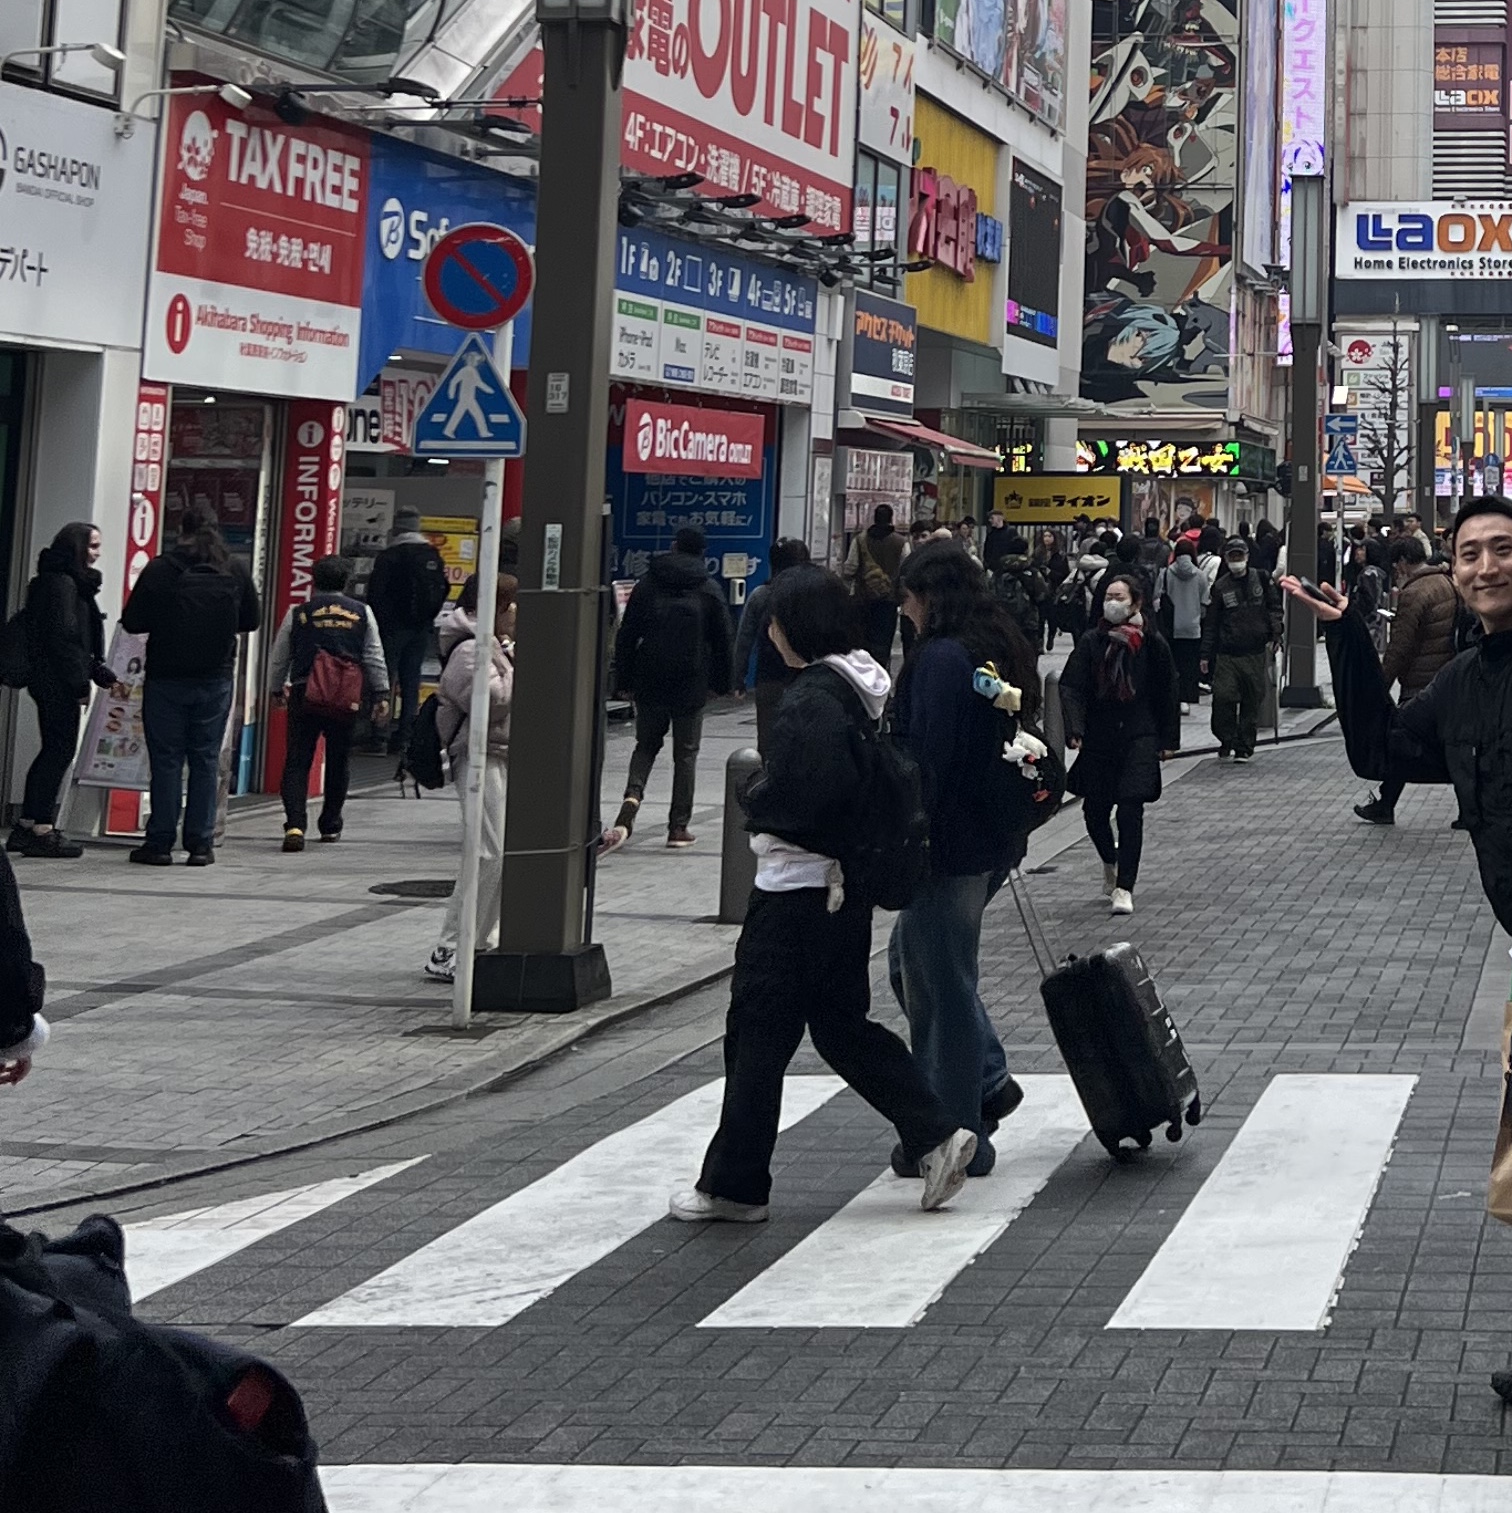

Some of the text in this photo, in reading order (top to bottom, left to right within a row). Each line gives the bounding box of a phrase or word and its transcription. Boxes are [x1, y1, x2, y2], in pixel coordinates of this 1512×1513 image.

[1435, 47, 1468, 63] 本店
[14, 146, 101, 190] GASHAPON
[225, 118, 361, 213] TAX FREE
[621, 236, 637, 276] 1F
[665, 250, 682, 287] 2F
[1353, 256, 1394, 270] Home
[1398, 256, 1474, 270] Electronics
[708, 262, 723, 298] 3F
[655, 418, 728, 462] BicCamera
[640, 491, 747, 506] パソコン・スマホ
[289, 456, 320, 604] INFORMAT
